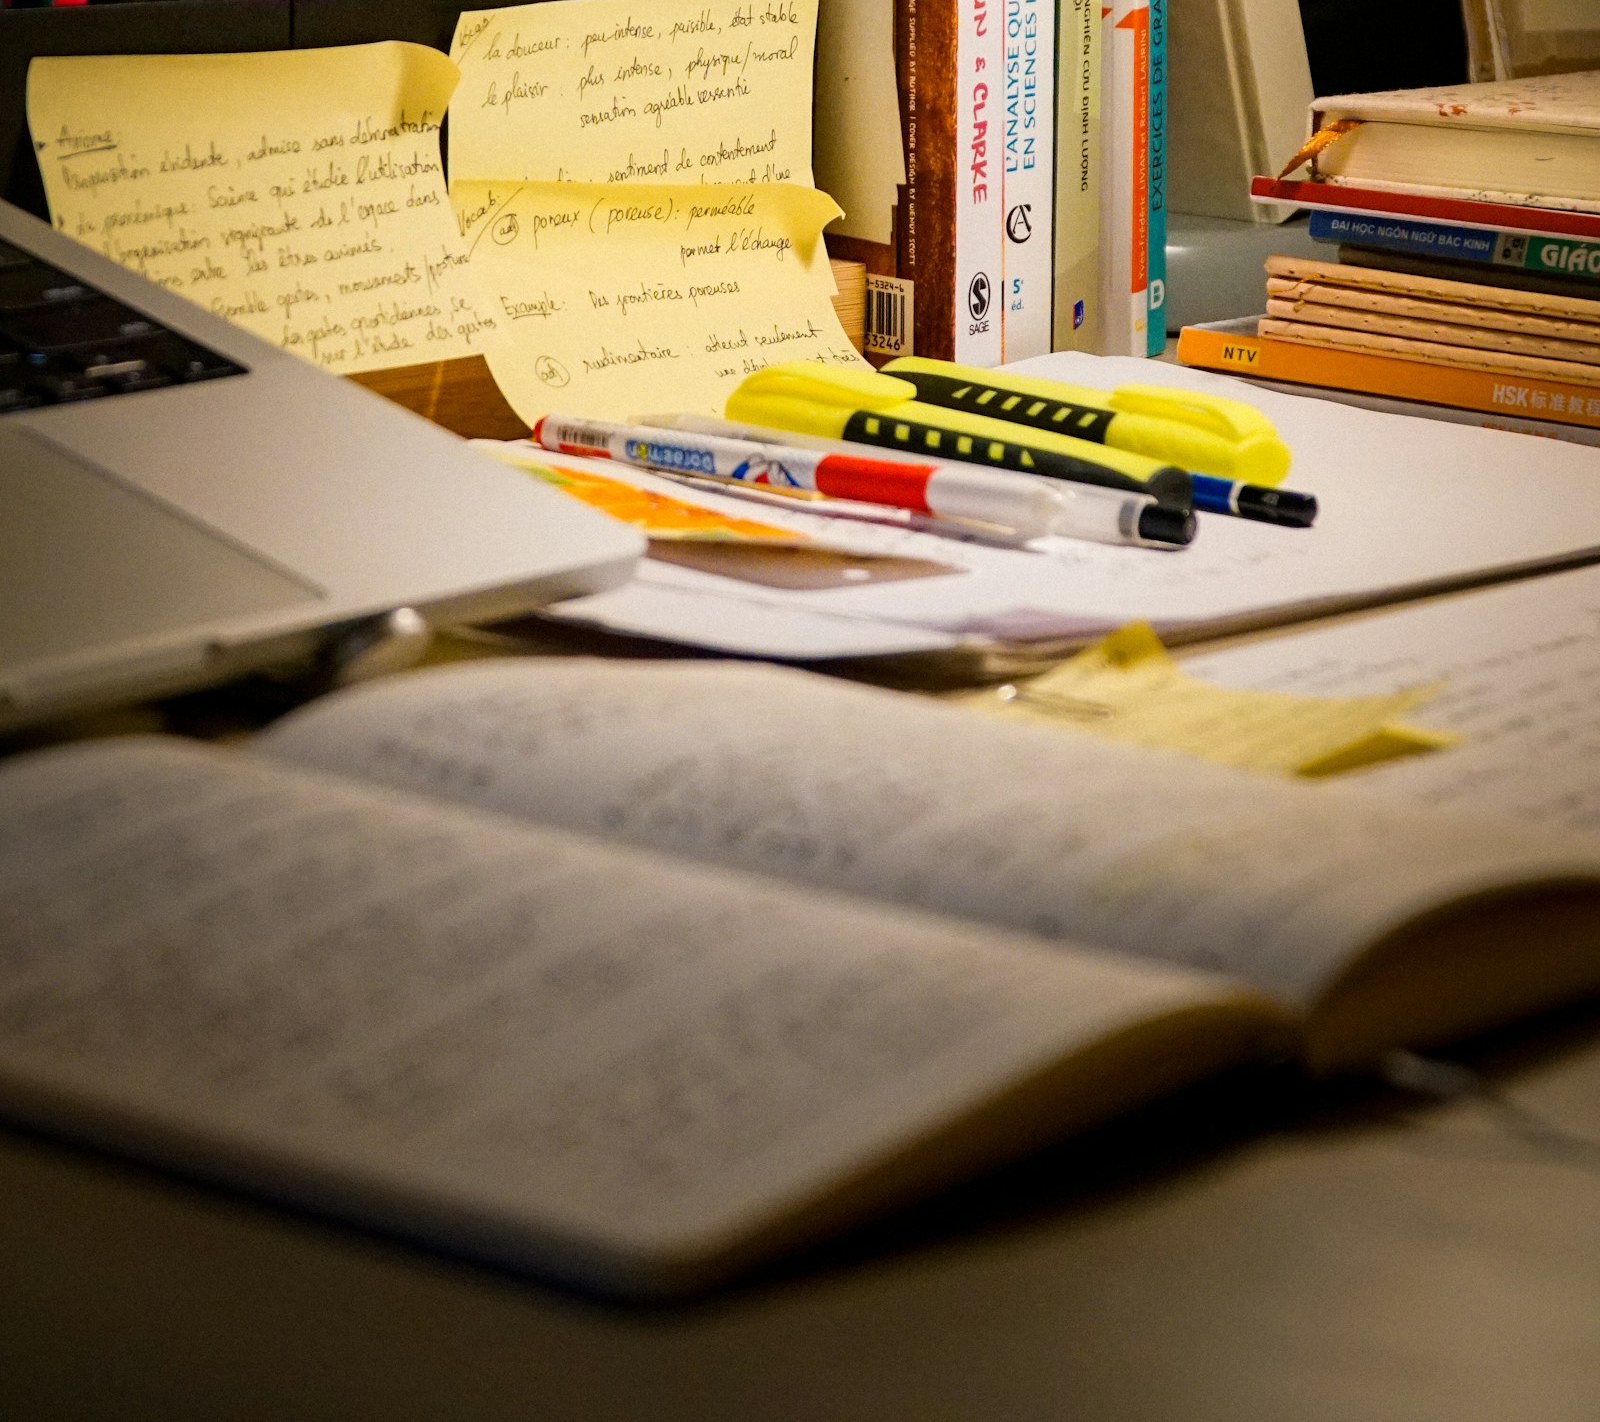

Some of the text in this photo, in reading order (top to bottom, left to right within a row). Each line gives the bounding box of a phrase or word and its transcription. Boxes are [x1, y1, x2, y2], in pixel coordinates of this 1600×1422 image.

[908, 17, 916, 57] SUPPLIED
[909, 60, 916, 73] BY
[975, 57, 986, 73] &
[1024, 12, 1036, 129] SCIENCES
[1153, 54, 1162, 84] DE
[908, 76, 916, 111] AUTHOR
[908, 123, 916, 149] COVER
[971, 82, 989, 205] CLARKE
[675, 148, 693, 170] de
[1023, 137, 1035, 170] EN
[1152, 94, 1163, 211] EXERCICES
[908, 153, 916, 185] DESIGN
[908, 188, 916, 200] BY
[908, 203, 916, 235] WENDY
[908, 238, 916, 267] SCOTT
[1463, 238, 1491, 251] KINH
[969, 320, 989, 336] SAGE
[1224, 346, 1258, 363] NTV
